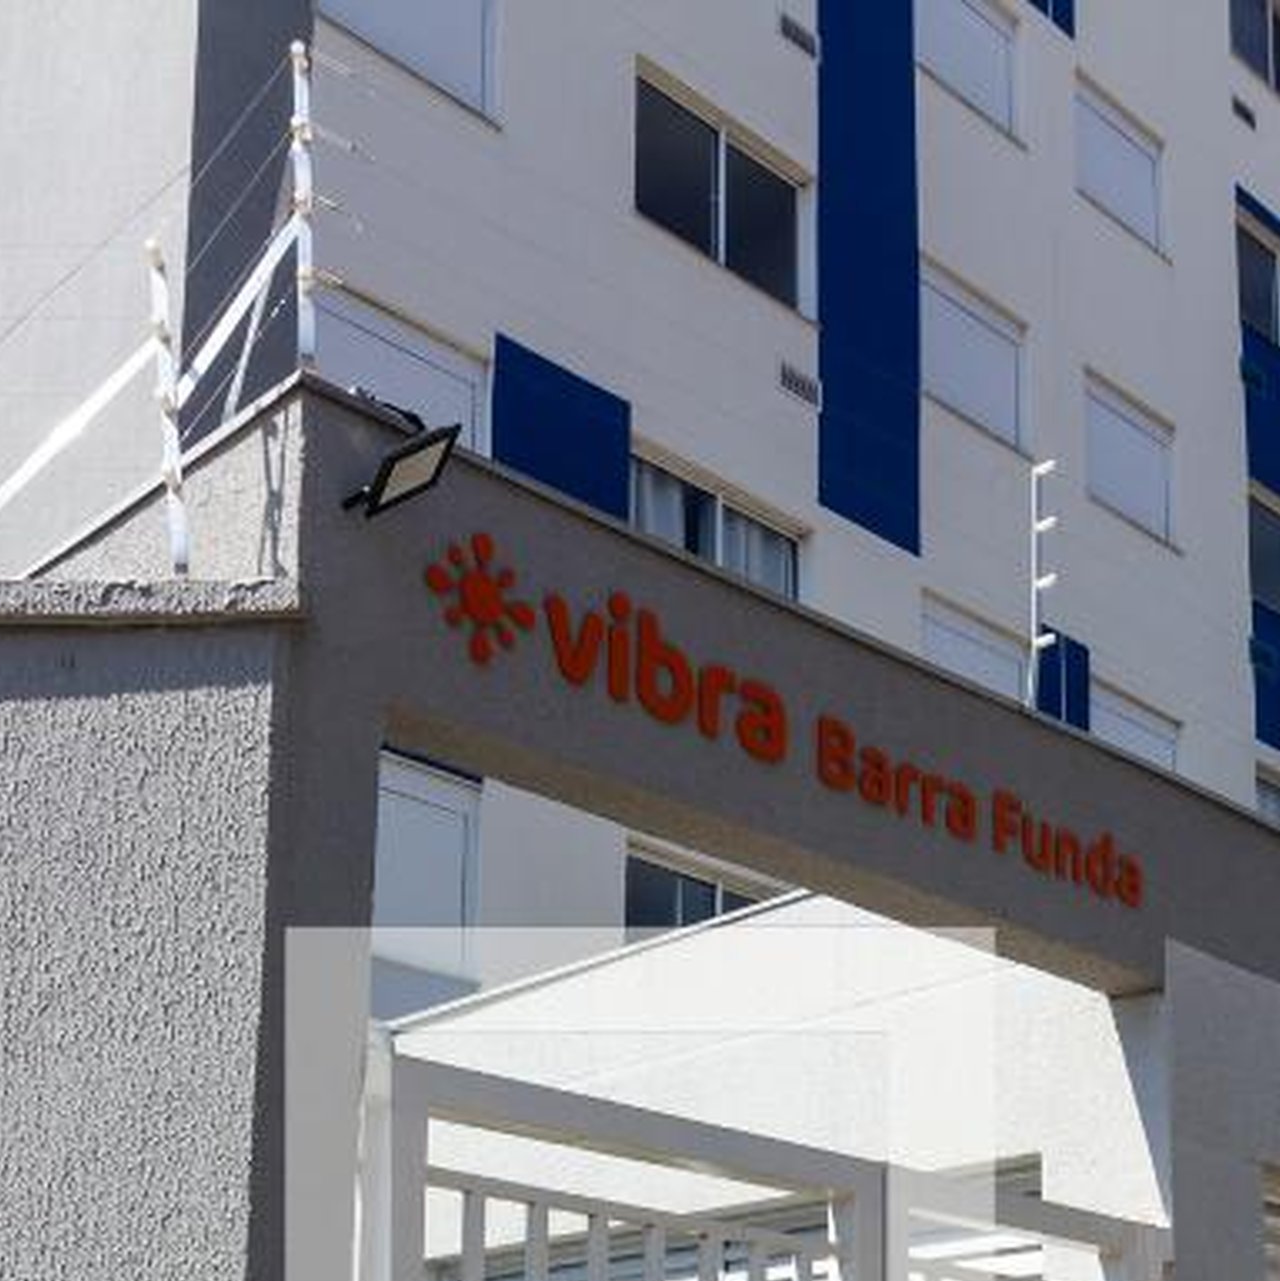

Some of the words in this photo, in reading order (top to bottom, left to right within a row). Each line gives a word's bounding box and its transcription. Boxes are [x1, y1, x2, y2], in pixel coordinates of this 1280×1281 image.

[545, 591, 789, 763] vibra
[815, 717, 978, 841] Barra
[993, 791, 1143, 909] Funda
